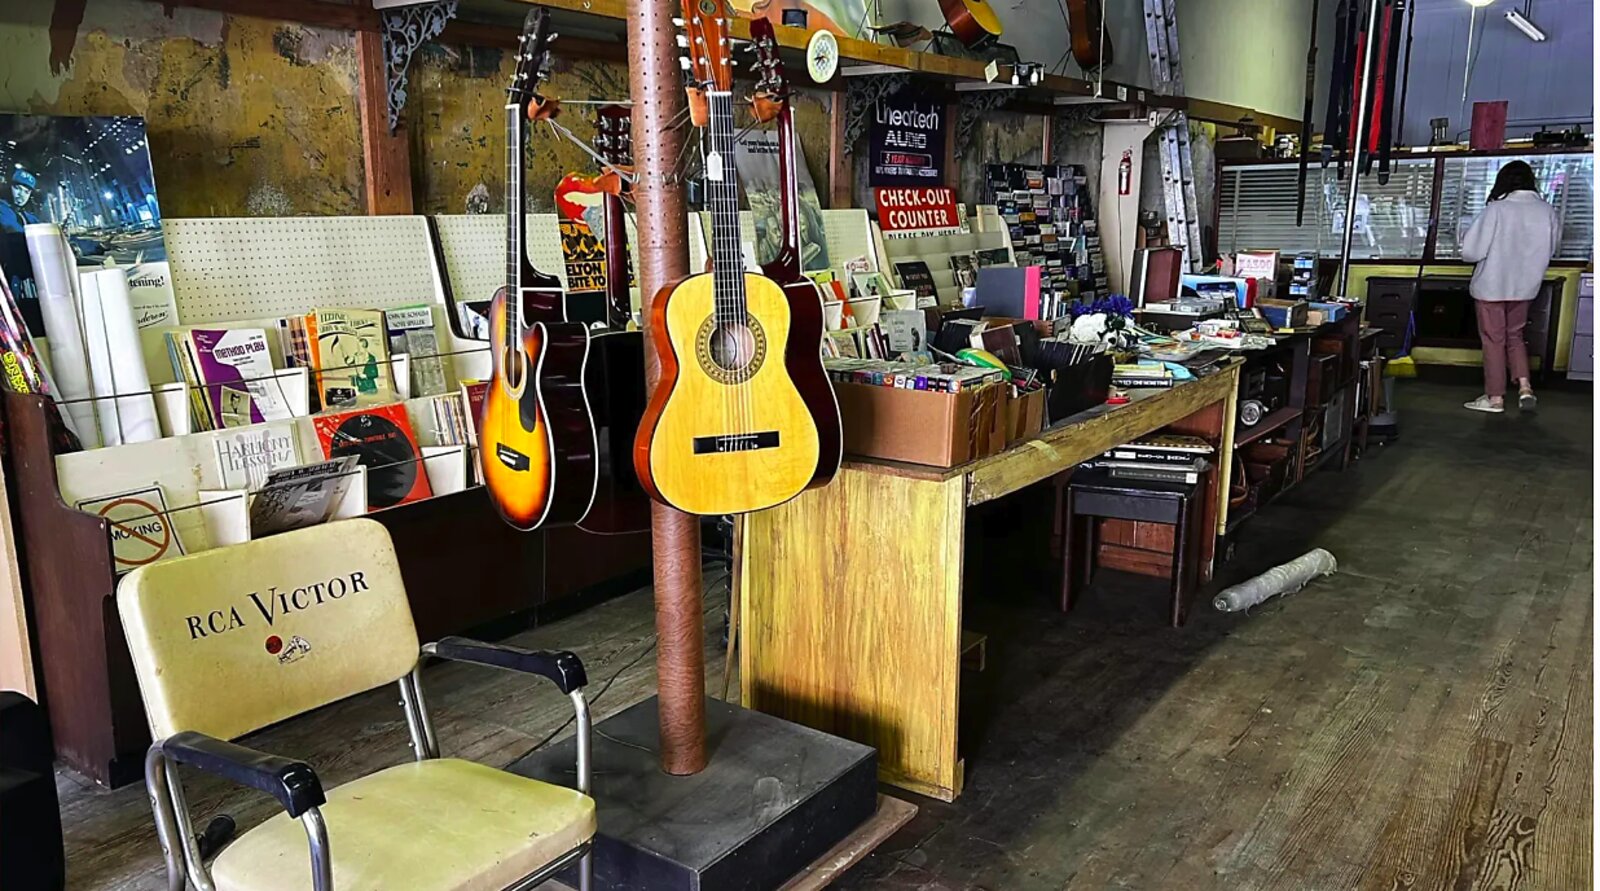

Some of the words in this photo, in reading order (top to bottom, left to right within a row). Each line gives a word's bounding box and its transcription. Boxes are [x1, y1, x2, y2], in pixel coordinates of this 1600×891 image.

[875, 98, 939, 130] Lineartech
[884, 130, 927, 149] AUDIO
[880, 188, 951, 207] CHECK-OUT
[889, 209, 949, 228] COUNTER
[566, 262, 601, 276] ELTON
[128, 275, 165, 288] tening!
[568, 276, 591, 289] BITE
[591, 275, 606, 287] YO
[111, 521, 162, 540] MOKING
[185, 605, 246, 640] RCA
